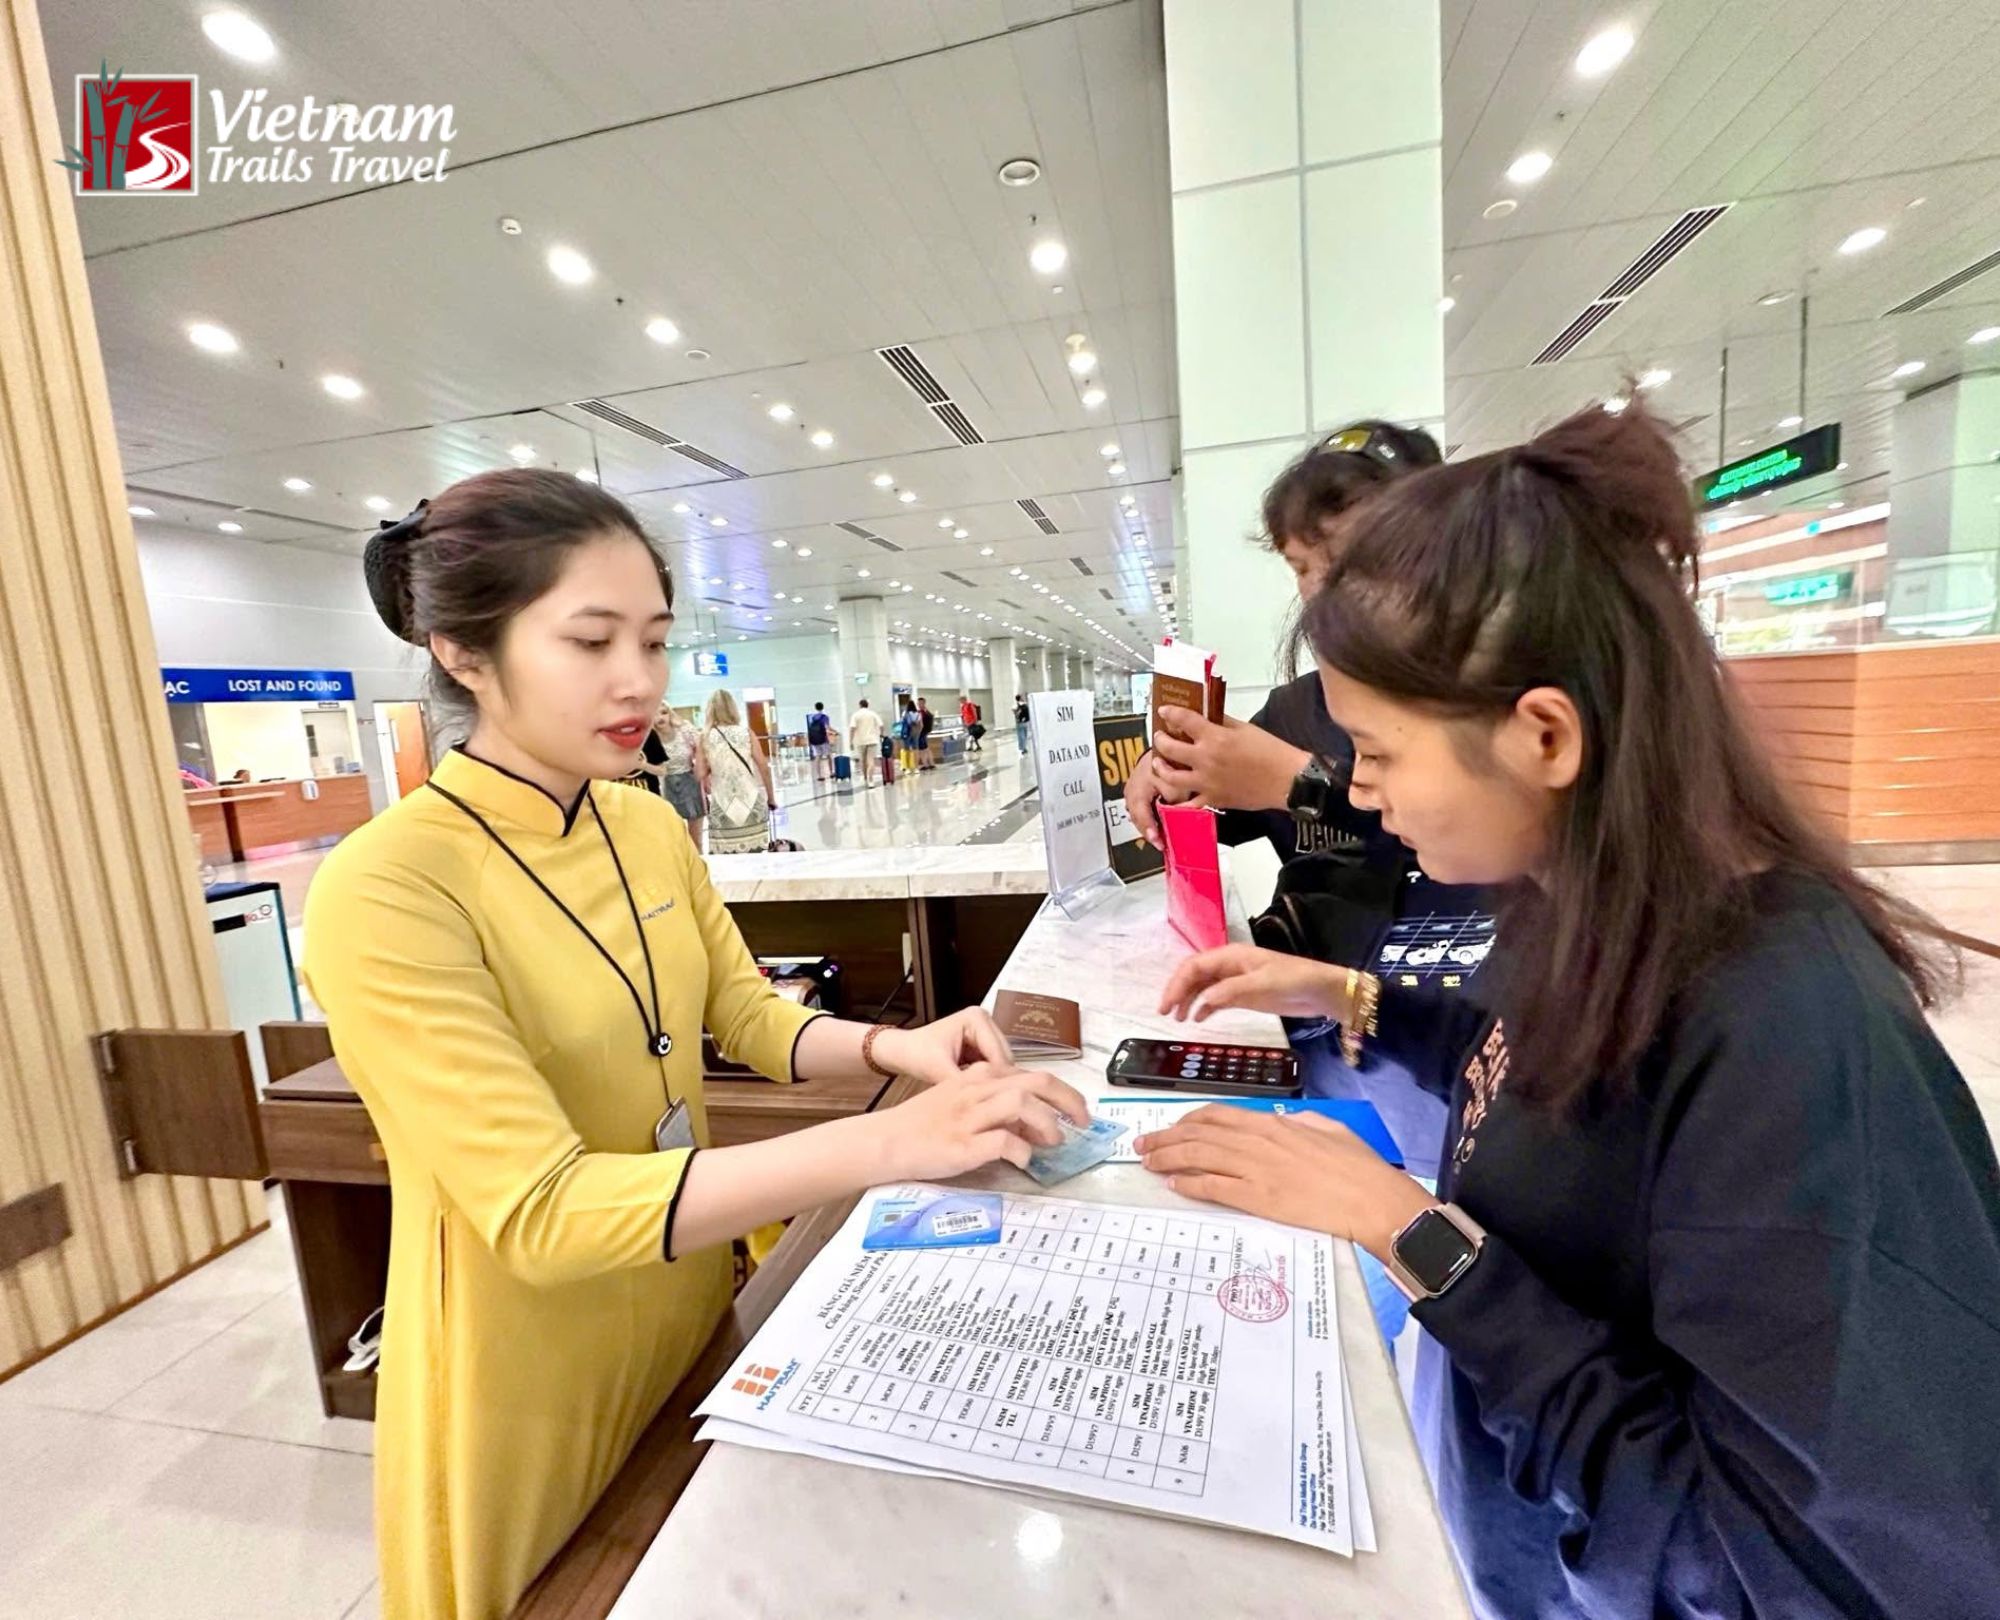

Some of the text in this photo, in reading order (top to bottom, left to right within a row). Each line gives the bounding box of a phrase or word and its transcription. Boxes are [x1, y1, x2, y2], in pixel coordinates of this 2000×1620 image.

[228, 679, 342, 692] LOST AND FOUND
[1056, 705, 1075, 723] SIM
[1049, 744, 1091, 764] DATA AND
[1063, 779, 1085, 797] CALL
[852, 1265, 877, 1295] Simcard
[988, 1309, 1000, 1326] DATA
[1017, 1315, 1036, 1351] ONLY DATA
[1055, 1321, 1072, 1358] ONLY DATA
[896, 1347, 907, 1359] SIM
[898, 1340, 921, 1372] MOBIFONE
[1094, 1328, 1110, 1366] ONLY DATA
[1139, 1323, 1156, 1374] DATA AND CALL
[1176, 1329, 1191, 1380] DATA AND CALL
[929, 1343, 955, 1383] SIM VIETTEL
[967, 1351, 991, 1391] SIM VIETTEL
[1199, 1351, 1208, 1369] Speed
[1006, 1358, 1029, 1399] SIM VIETTEL
[1048, 1377, 1058, 1391] SIM
[1052, 1367, 1072, 1407] VINAPHONE
[798, 1395, 812, 1411] STT
[1062, 1389, 1074, 1412] D159V
[1089, 1386, 1099, 1400] SIM
[1095, 1375, 1112, 1417] VINAPHONE
[1132, 1393, 1141, 1408] SIM
[1139, 1383, 1154, 1425] VINAPHONE
[995, 1407, 1008, 1428] ESIM
[1006, 1413, 1017, 1427] TEL
[1104, 1398, 1116, 1421] D159V
[1148, 1406, 1159, 1429] D159V
[1176, 1402, 1184, 1416] SIM
[1184, 1390, 1196, 1434] VINAPHONE
[1084, 1423, 1097, 1450] D159V7
[1194, 1415, 1204, 1438] D159V
[1130, 1434, 1142, 1457] D159V
[1299, 1442, 1307, 1462] Group
